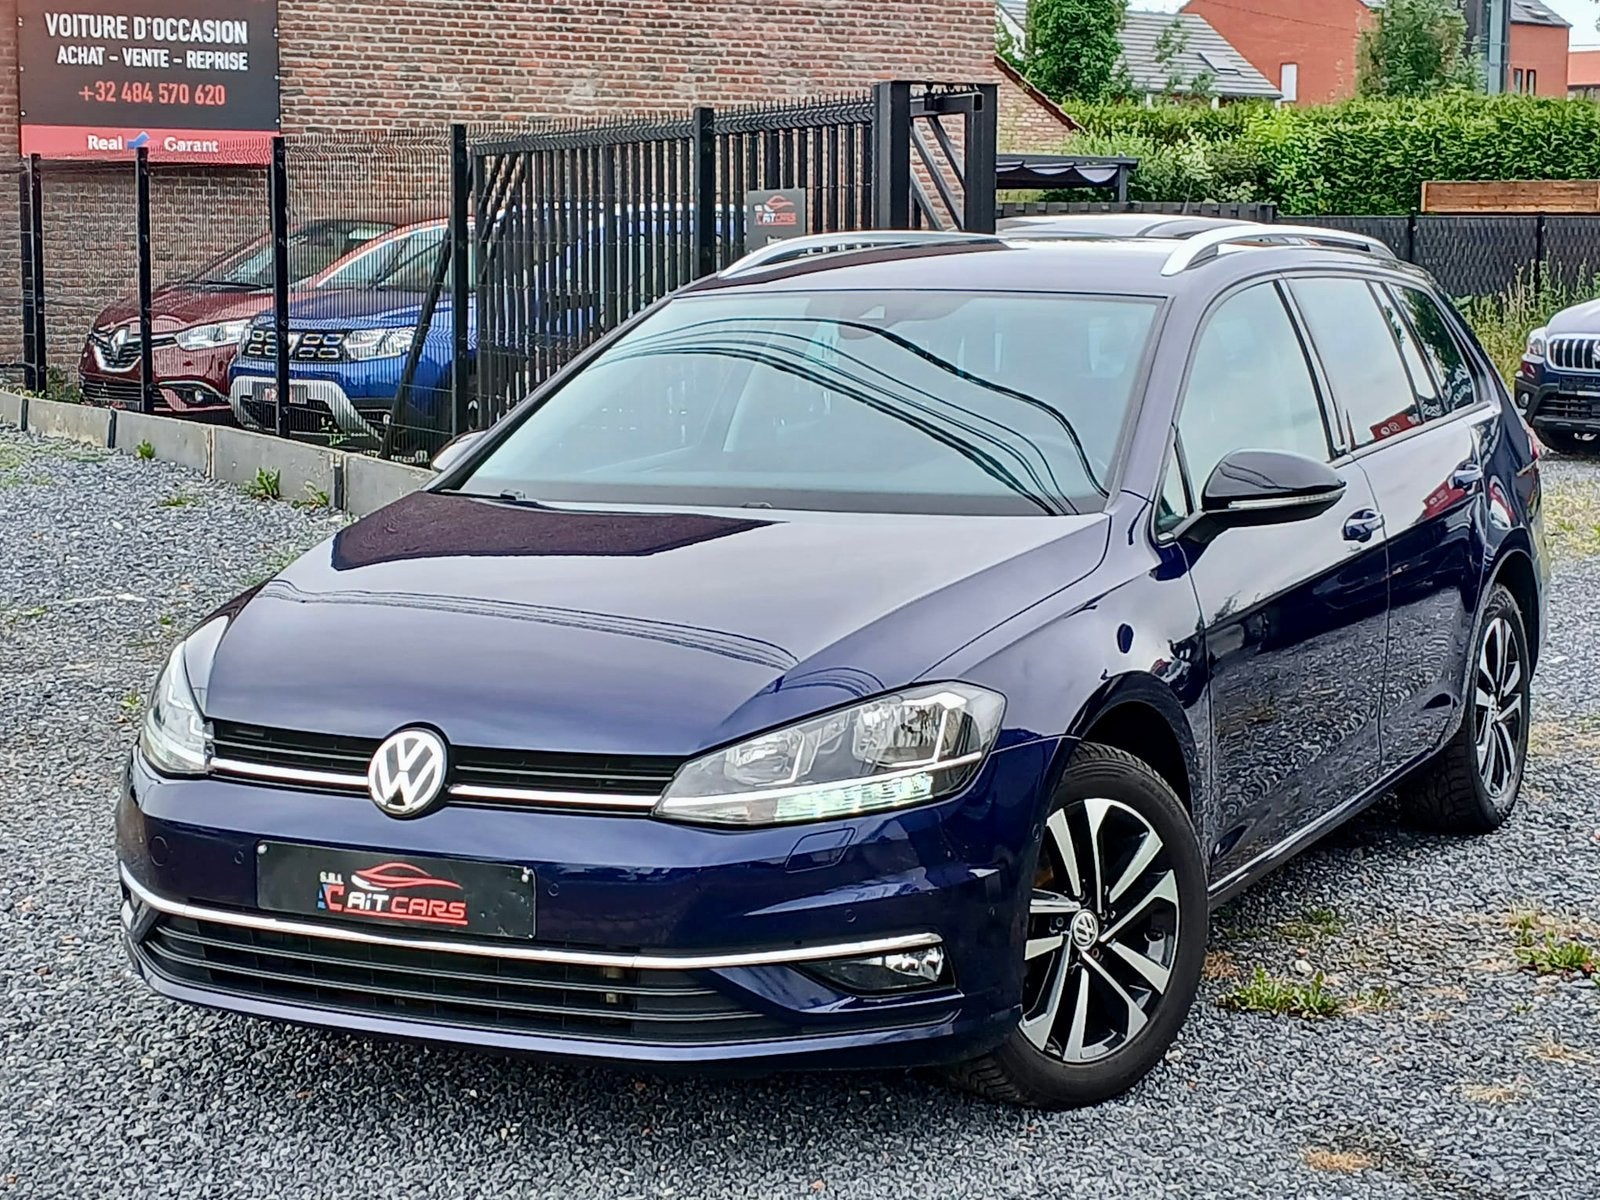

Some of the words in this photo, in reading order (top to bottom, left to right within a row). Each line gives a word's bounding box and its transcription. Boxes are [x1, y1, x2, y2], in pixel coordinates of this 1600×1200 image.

[45, 13, 128, 40] VOITURE
[133, 17, 248, 44] D'OCCASION
[57, 46, 105, 65] ACHAT
[122, 48, 169, 67] VENTE
[186, 51, 248, 71] REPRISE
[78, 81, 116, 102] +32
[121, 82, 153, 103] 484
[158, 83, 189, 104] 570
[195, 85, 226, 105] 620
[87, 135, 123, 150] Real
[163, 137, 219, 153] Garant
[390, 897, 467, 919] CARS
